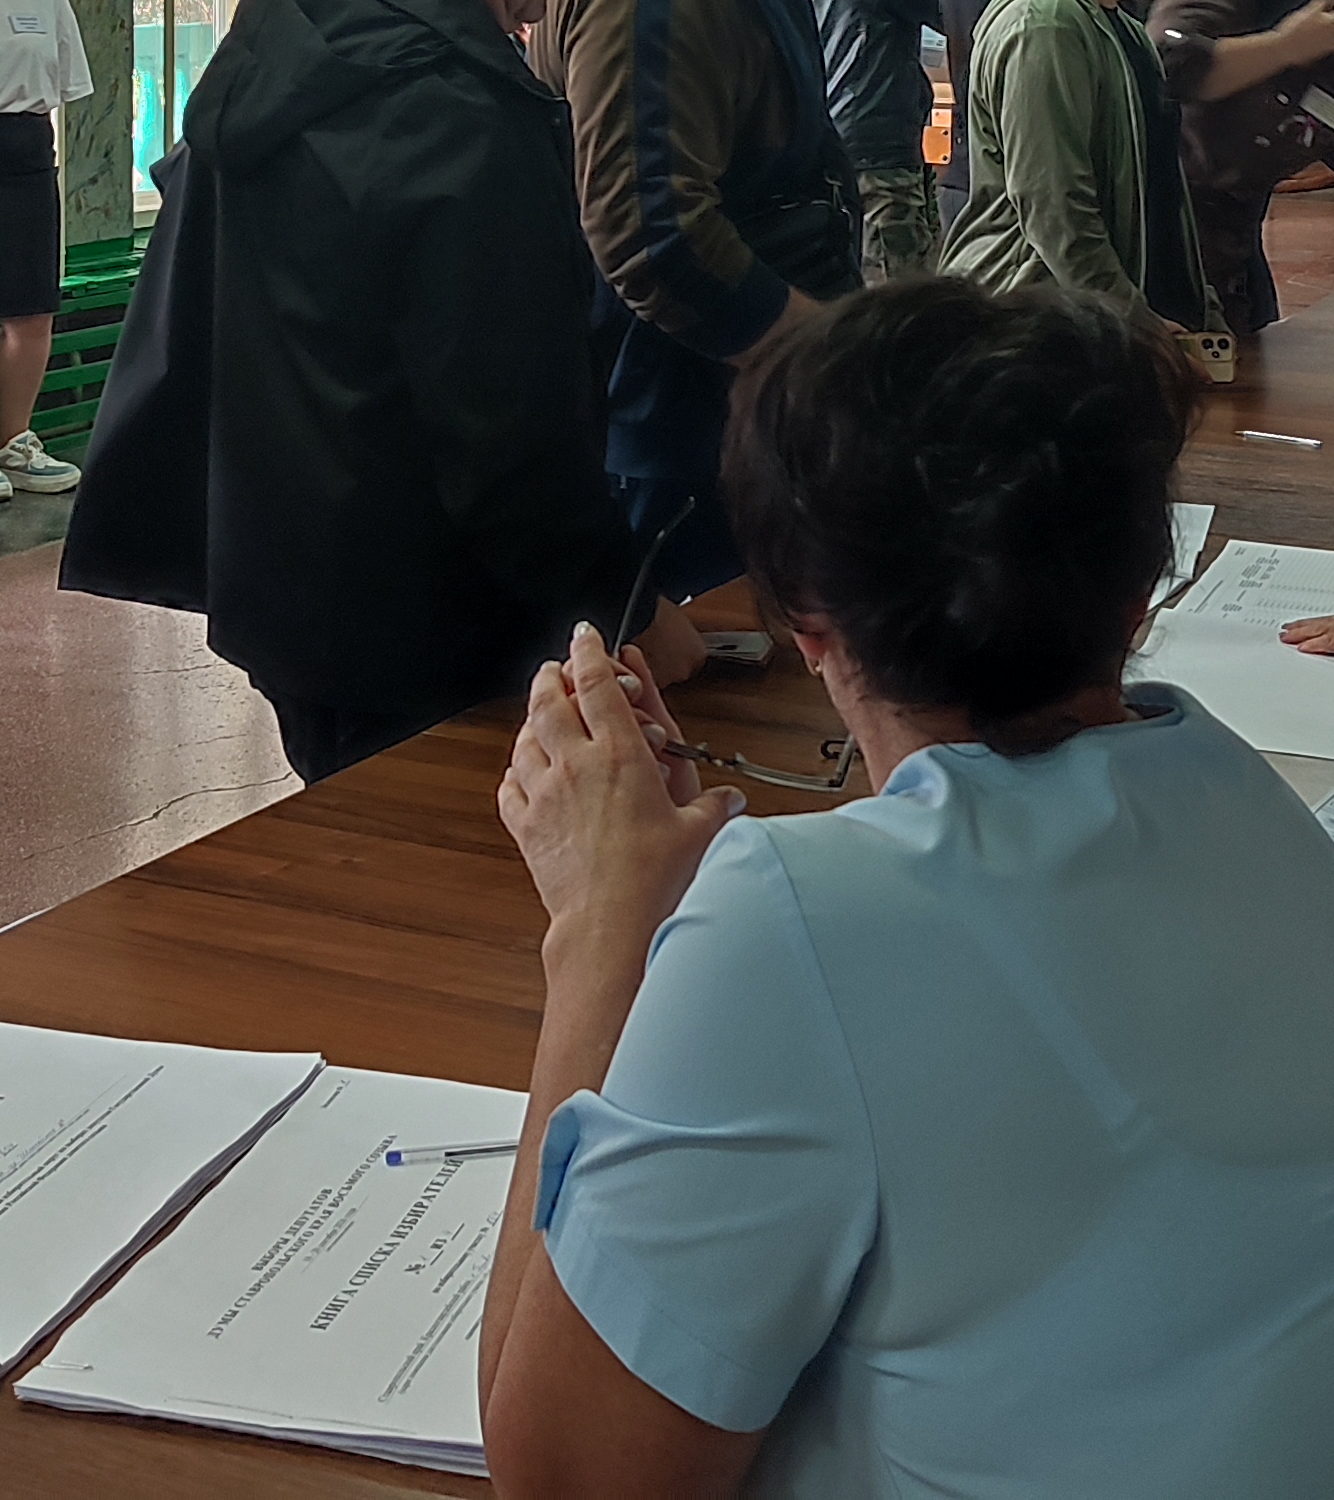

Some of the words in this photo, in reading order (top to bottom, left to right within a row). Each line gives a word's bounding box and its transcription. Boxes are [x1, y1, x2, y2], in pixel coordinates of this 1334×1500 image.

[250, 1236, 291, 1271] ВЫБОРЫ
[283, 1187, 333, 1236] ДЕПУТАТОВ
[308, 1286, 359, 1331] КНИГА
[346, 1239, 401, 1287] СПИСКА
[388, 1157, 464, 1239] ИЗБИРАТЕЛЕЙ
